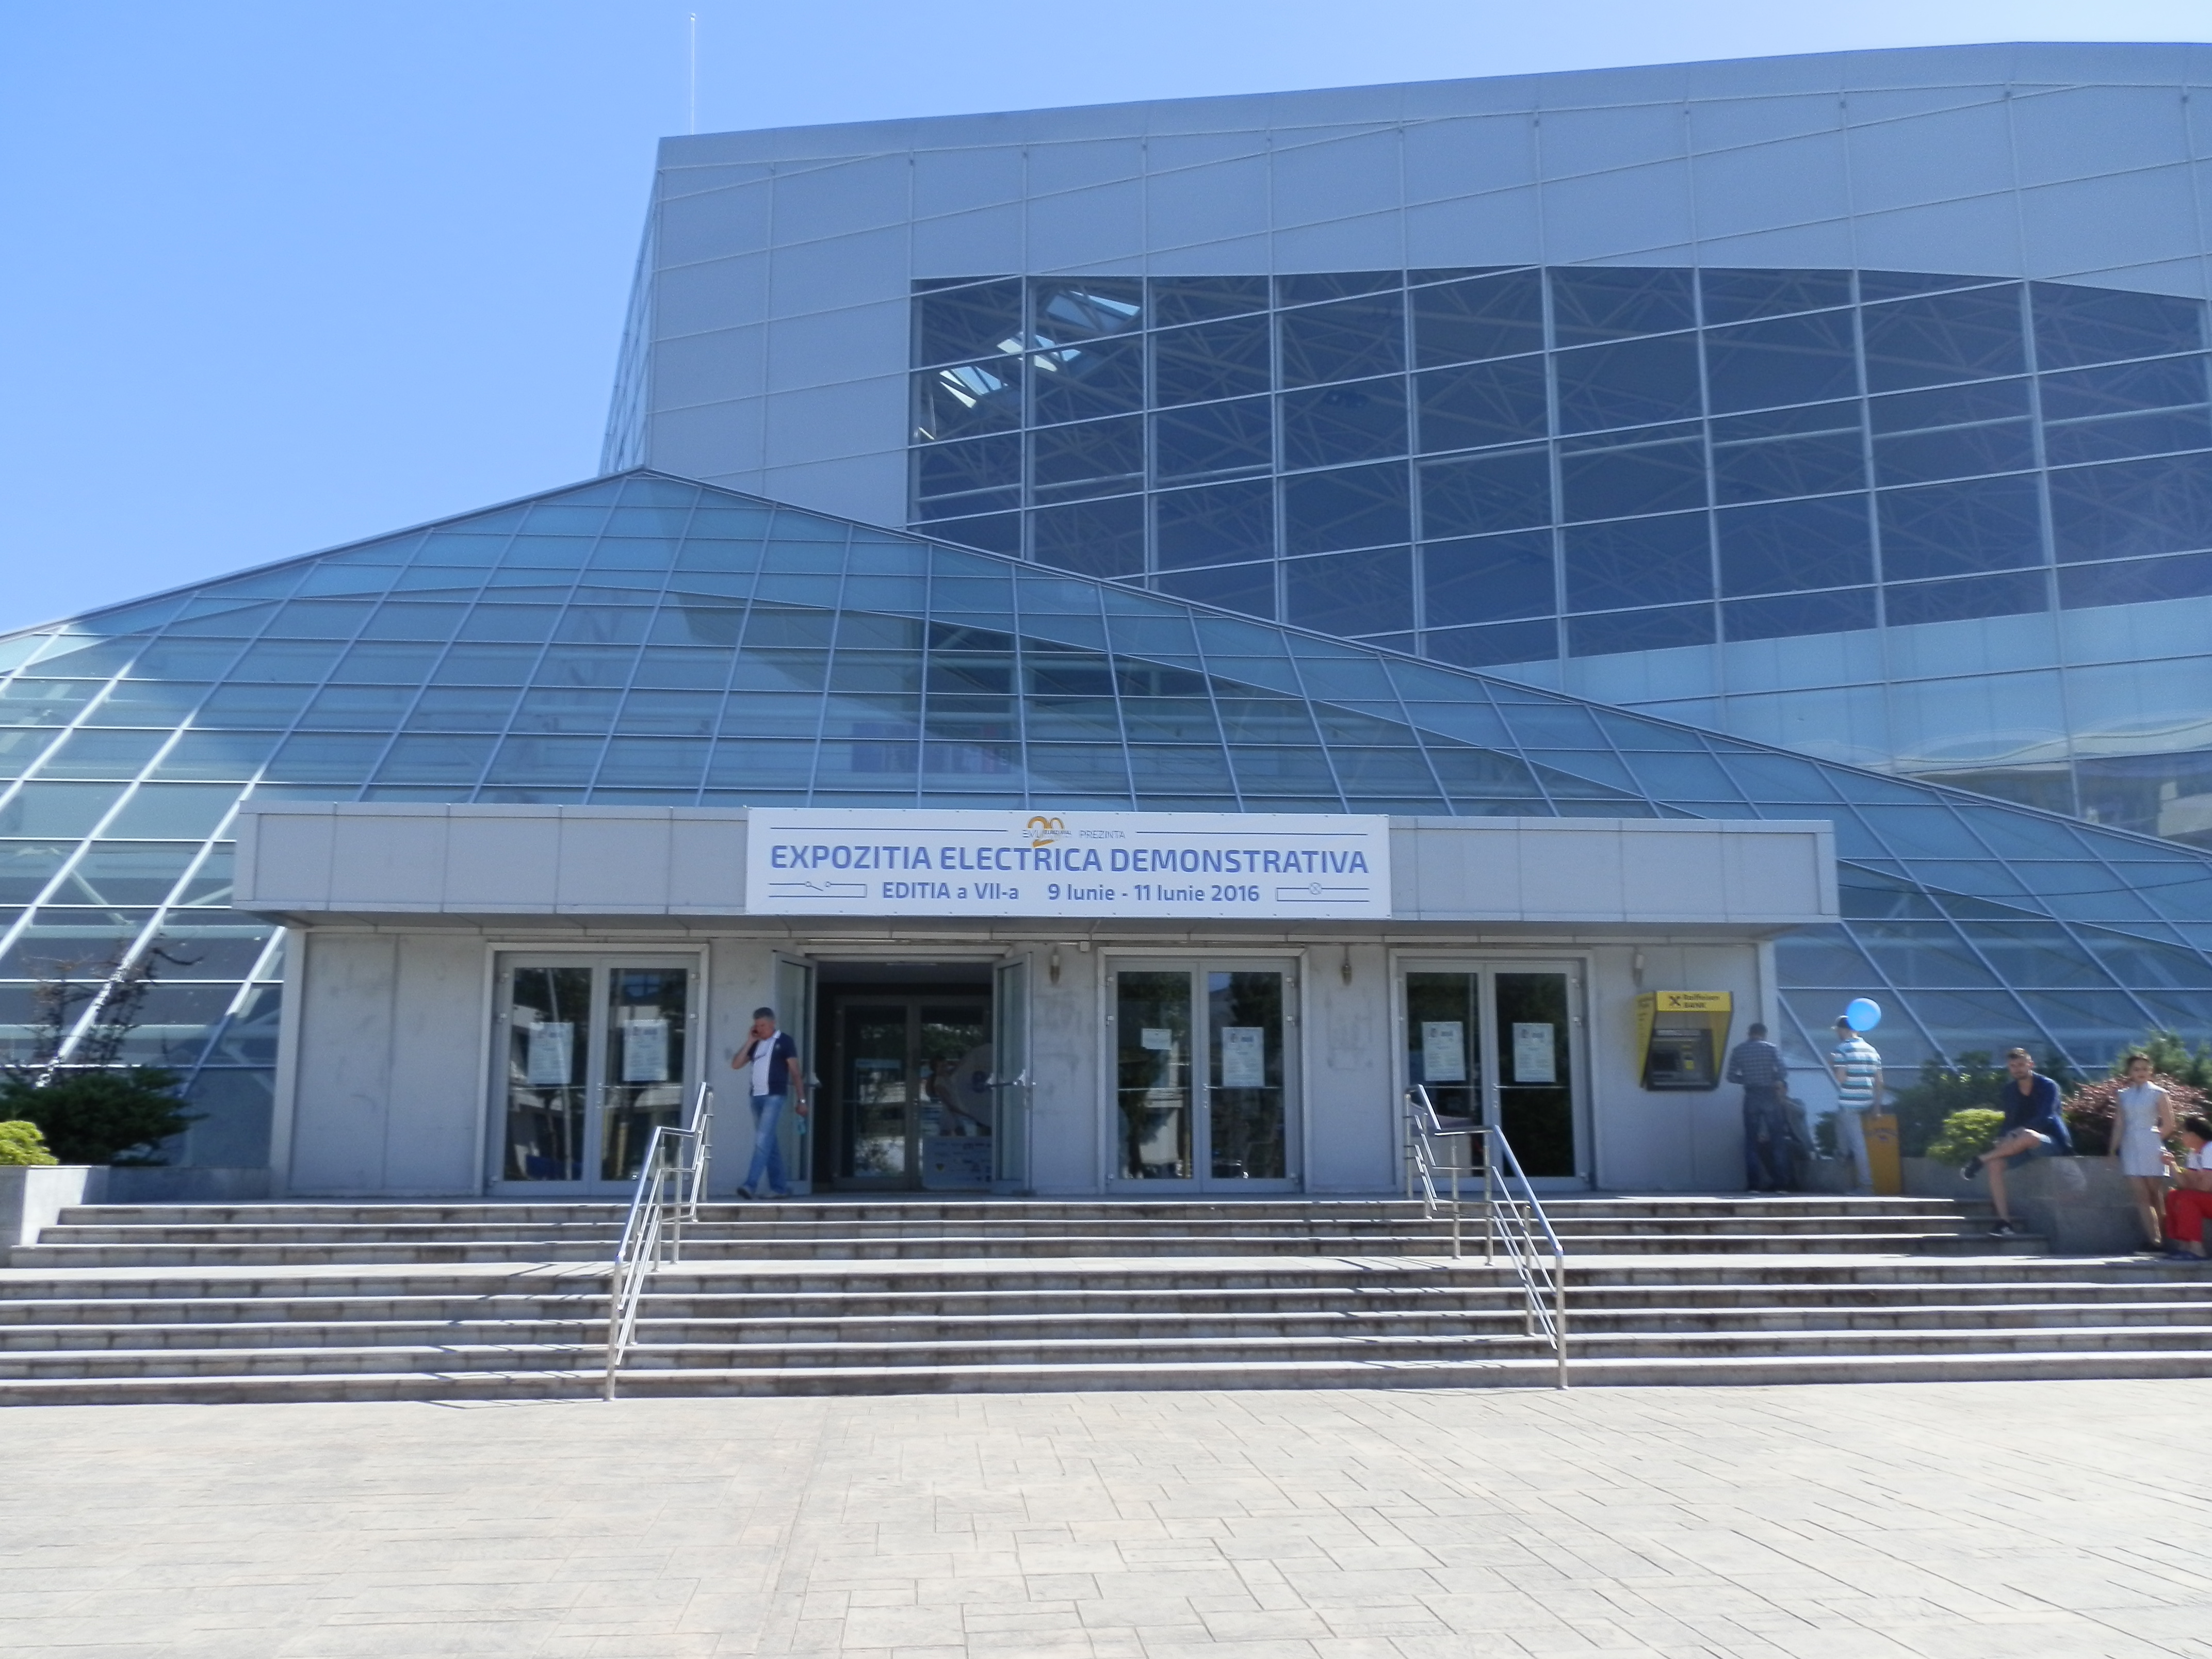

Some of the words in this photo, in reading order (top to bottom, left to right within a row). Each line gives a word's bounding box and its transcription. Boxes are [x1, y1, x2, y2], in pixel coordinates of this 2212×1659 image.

[1079, 829, 1126, 839] PREZINTA
[771, 845, 933, 869] EXPOZITIA
[940, 847, 1102, 871] ELECTRICA
[1111, 849, 1369, 873] DEMONSTRATIVA
[883, 882, 951, 899] EDITIA
[957, 887, 967, 899] a
[974, 883, 1019, 900] VII-a
[1048, 883, 1060, 900] 9
[1067, 884, 1115, 901] Iunie
[1134, 884, 1151, 901] 11
[1158, 885, 1205, 901] Iunie
[1211, 885, 1259, 902] 2016
